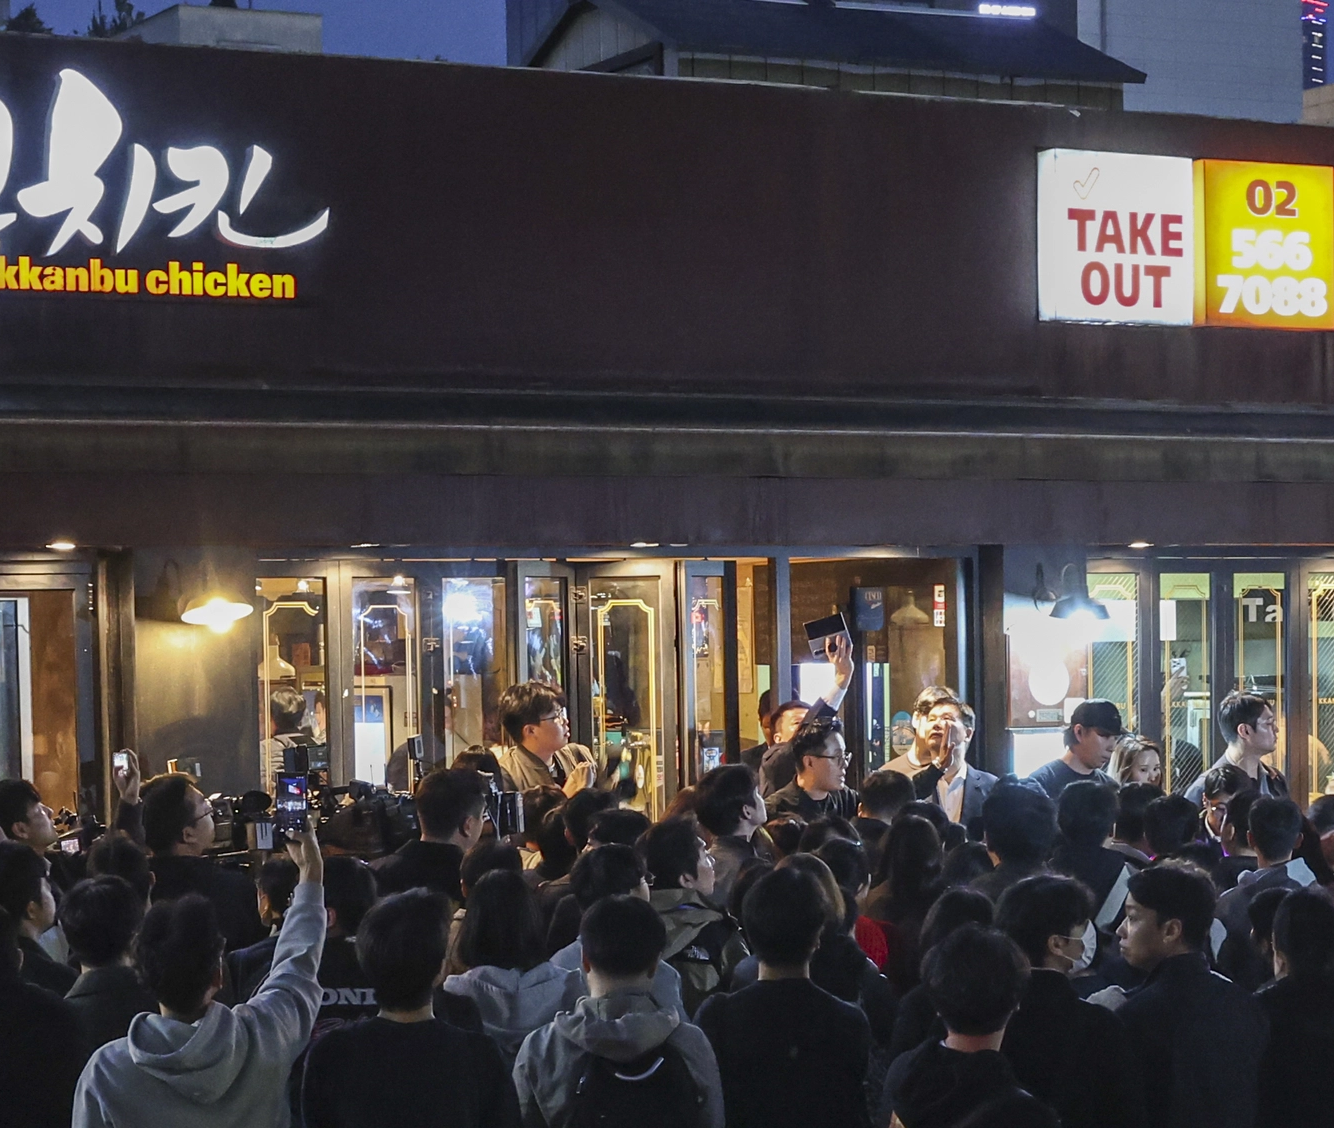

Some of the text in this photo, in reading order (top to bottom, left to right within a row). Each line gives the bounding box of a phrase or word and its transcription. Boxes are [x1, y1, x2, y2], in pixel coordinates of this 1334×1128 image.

[1245, 179, 1299, 217] 02
[1068, 208, 1183, 257] TAKE
[1230, 228, 1313, 271] 566
[145, 259, 295, 298] chicken
[1081, 261, 1171, 308] OUT
[1216, 274, 1328, 317] 7088
